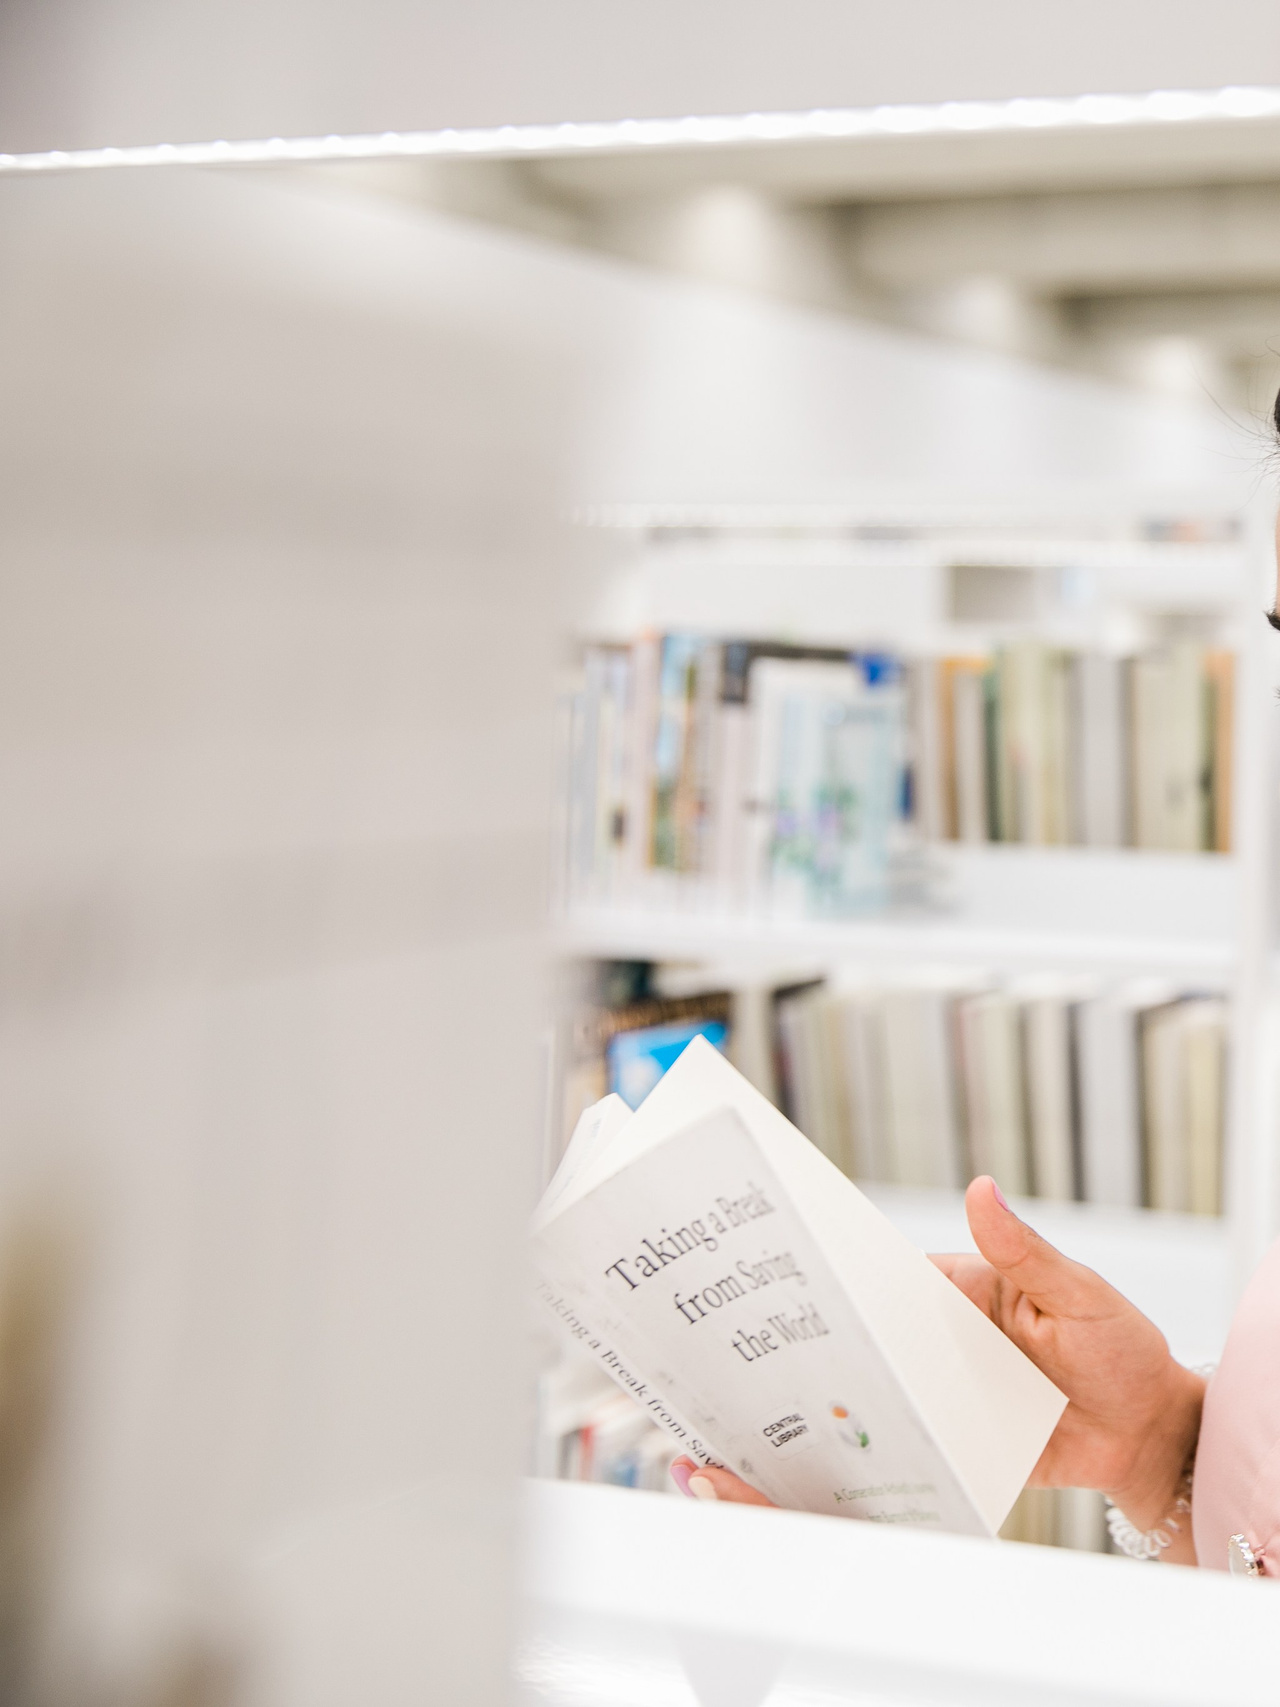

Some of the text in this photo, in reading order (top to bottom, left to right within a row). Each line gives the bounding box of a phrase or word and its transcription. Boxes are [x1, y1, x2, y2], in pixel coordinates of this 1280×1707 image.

[604, 1180, 776, 1291] Taking a Break
[673, 1250, 807, 1325] from Saving
[536, 1281, 590, 1340] Taking
[587, 1339, 602, 1350] a
[600, 1349, 649, 1398] Break
[647, 1399, 688, 1439] from
[731, 1301, 829, 1362] the World
[762, 1412, 805, 1438] CENTRAL
[770, 1423, 810, 1448] LIBRARY
